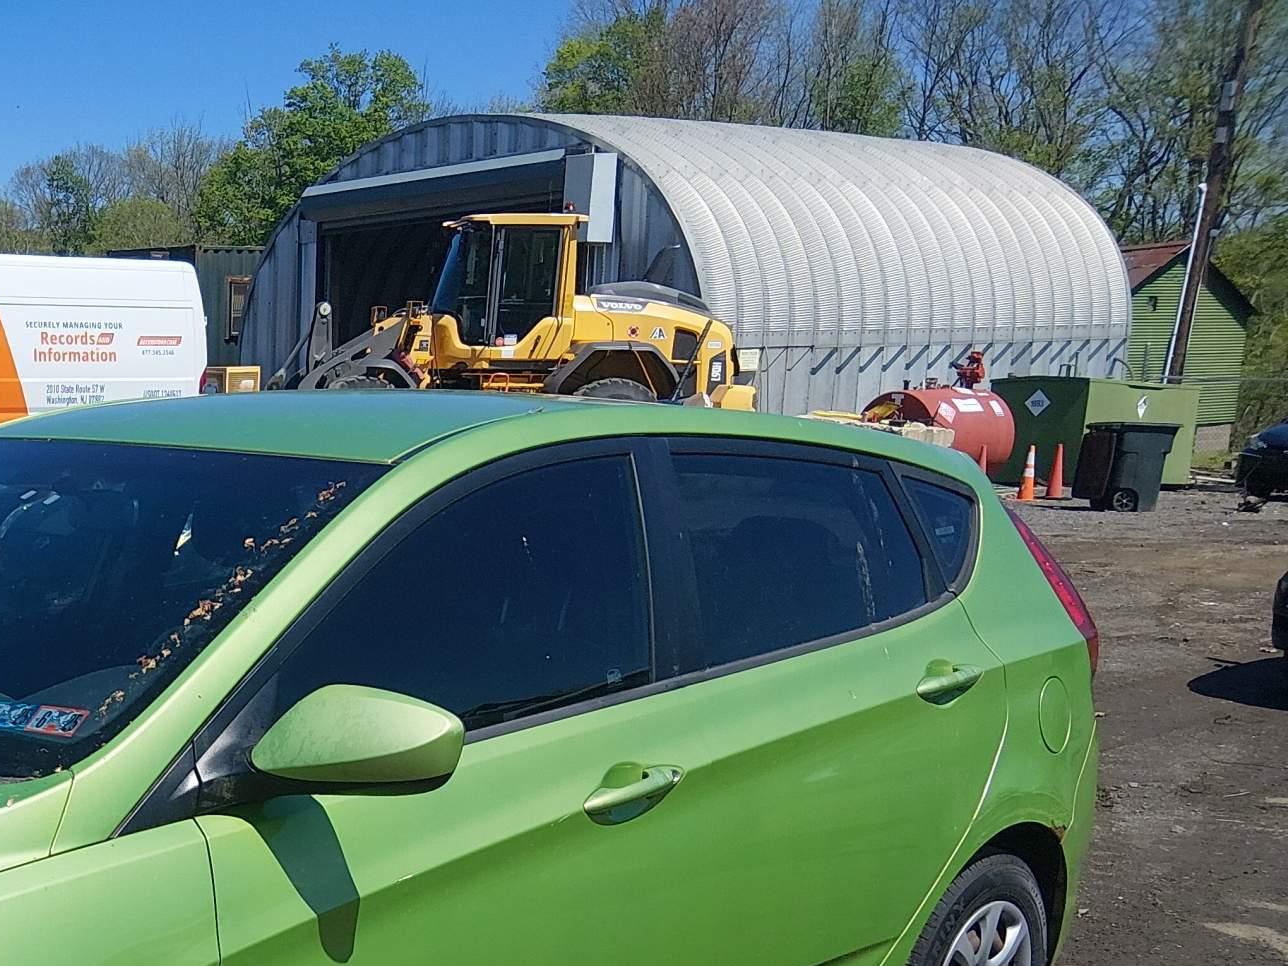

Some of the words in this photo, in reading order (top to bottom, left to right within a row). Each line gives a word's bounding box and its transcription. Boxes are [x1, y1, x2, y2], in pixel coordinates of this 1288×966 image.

[600, 301, 643, 310] VOLVO
[25, 321, 60, 329] SECURELY
[62, 321, 102, 330] MANAGING
[104, 322, 123, 330] YOUR
[40, 331, 95, 345] Records
[33, 347, 117, 362] Information
[46, 384, 60, 394] 2010
[60, 384, 74, 394] State
[75, 384, 91, 394] Route
[91, 384, 99, 393] 57
[99, 384, 105, 393] W
[35, 710, 53, 728] 6
